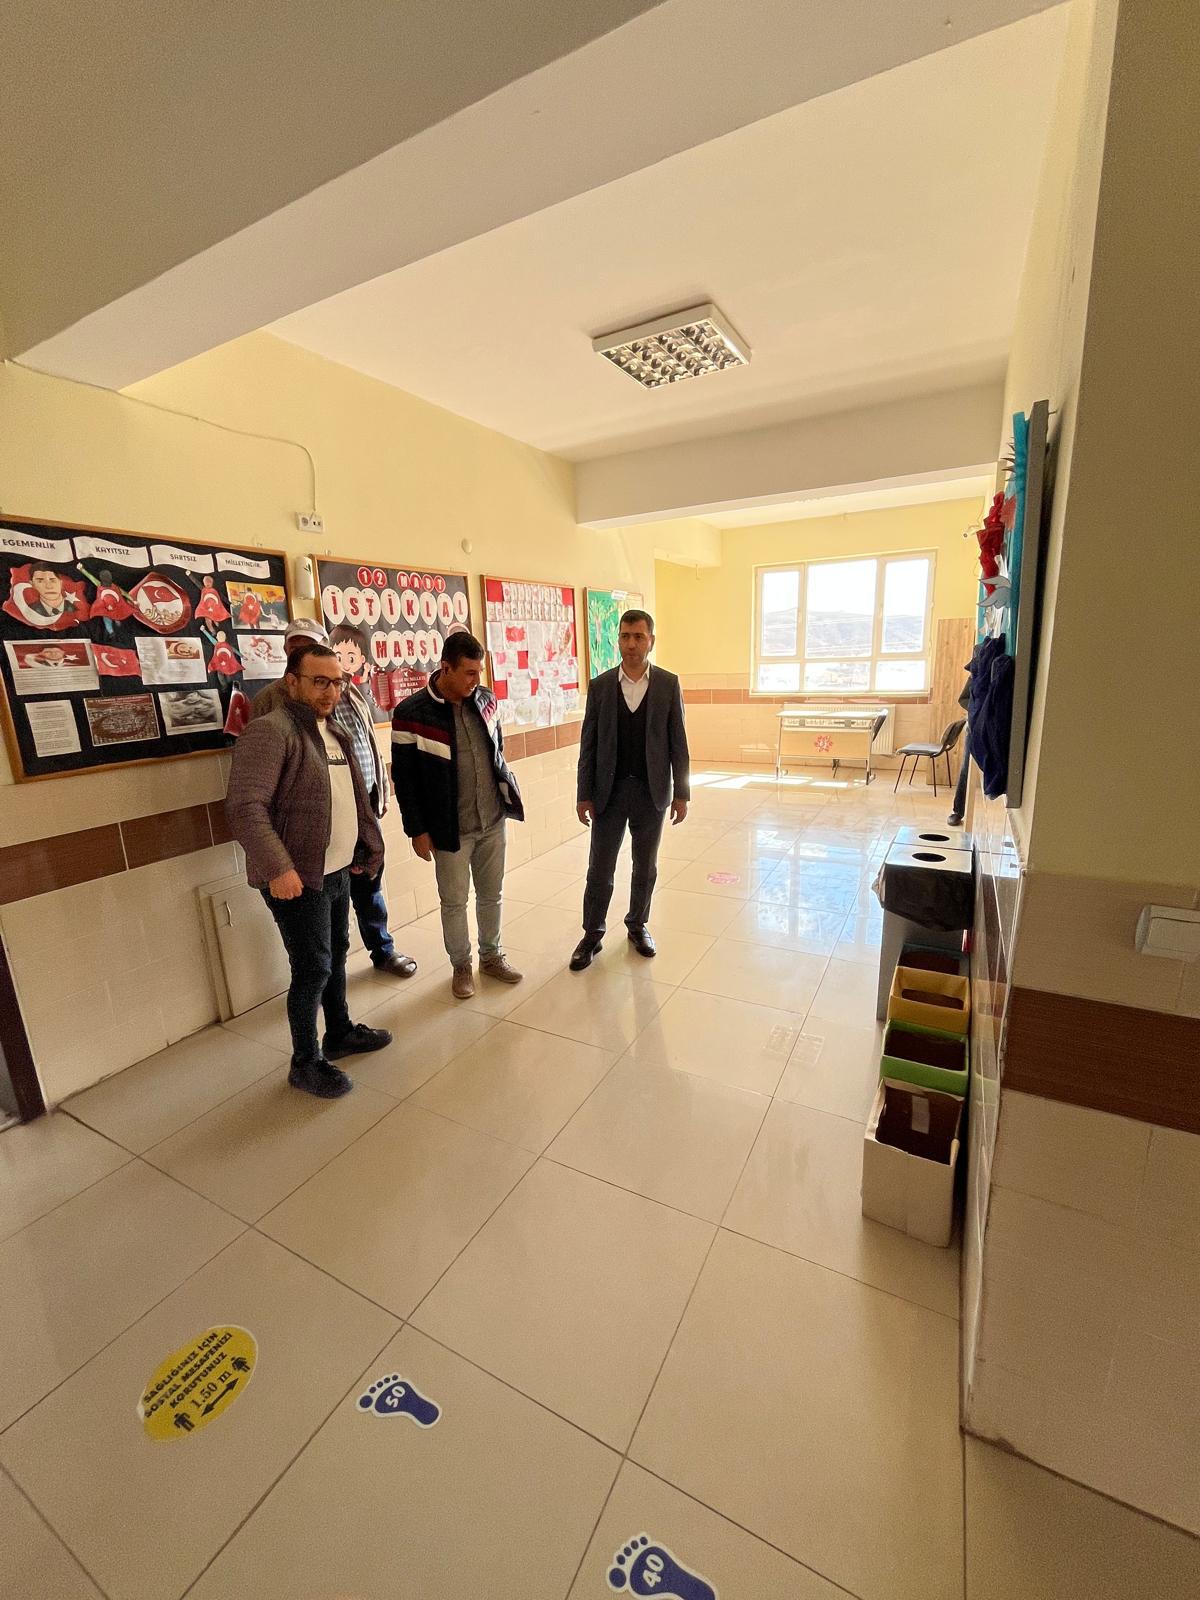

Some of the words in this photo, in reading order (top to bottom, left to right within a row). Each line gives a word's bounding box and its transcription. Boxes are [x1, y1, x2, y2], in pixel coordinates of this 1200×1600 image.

[2, 539, 56, 549] EGEMENLİK
[95, 546, 130, 556] KAYITSIZ
[361, 571, 384, 586] 12
[400, 572, 443, 592] MART
[331, 591, 463, 617] İSTİKLAL
[375, 638, 438, 659] MARŞI
[144, 1351, 199, 1403] SAĞLIĞINIZ
[198, 1332, 218, 1351] İÇİN
[217, 1370, 232, 1383] m
[170, 1351, 227, 1409] KORUYUNUZ
[145, 1384, 182, 1418] SOSYAL
[385, 1385, 406, 1408] 50
[642, 1553, 665, 1588] 40
